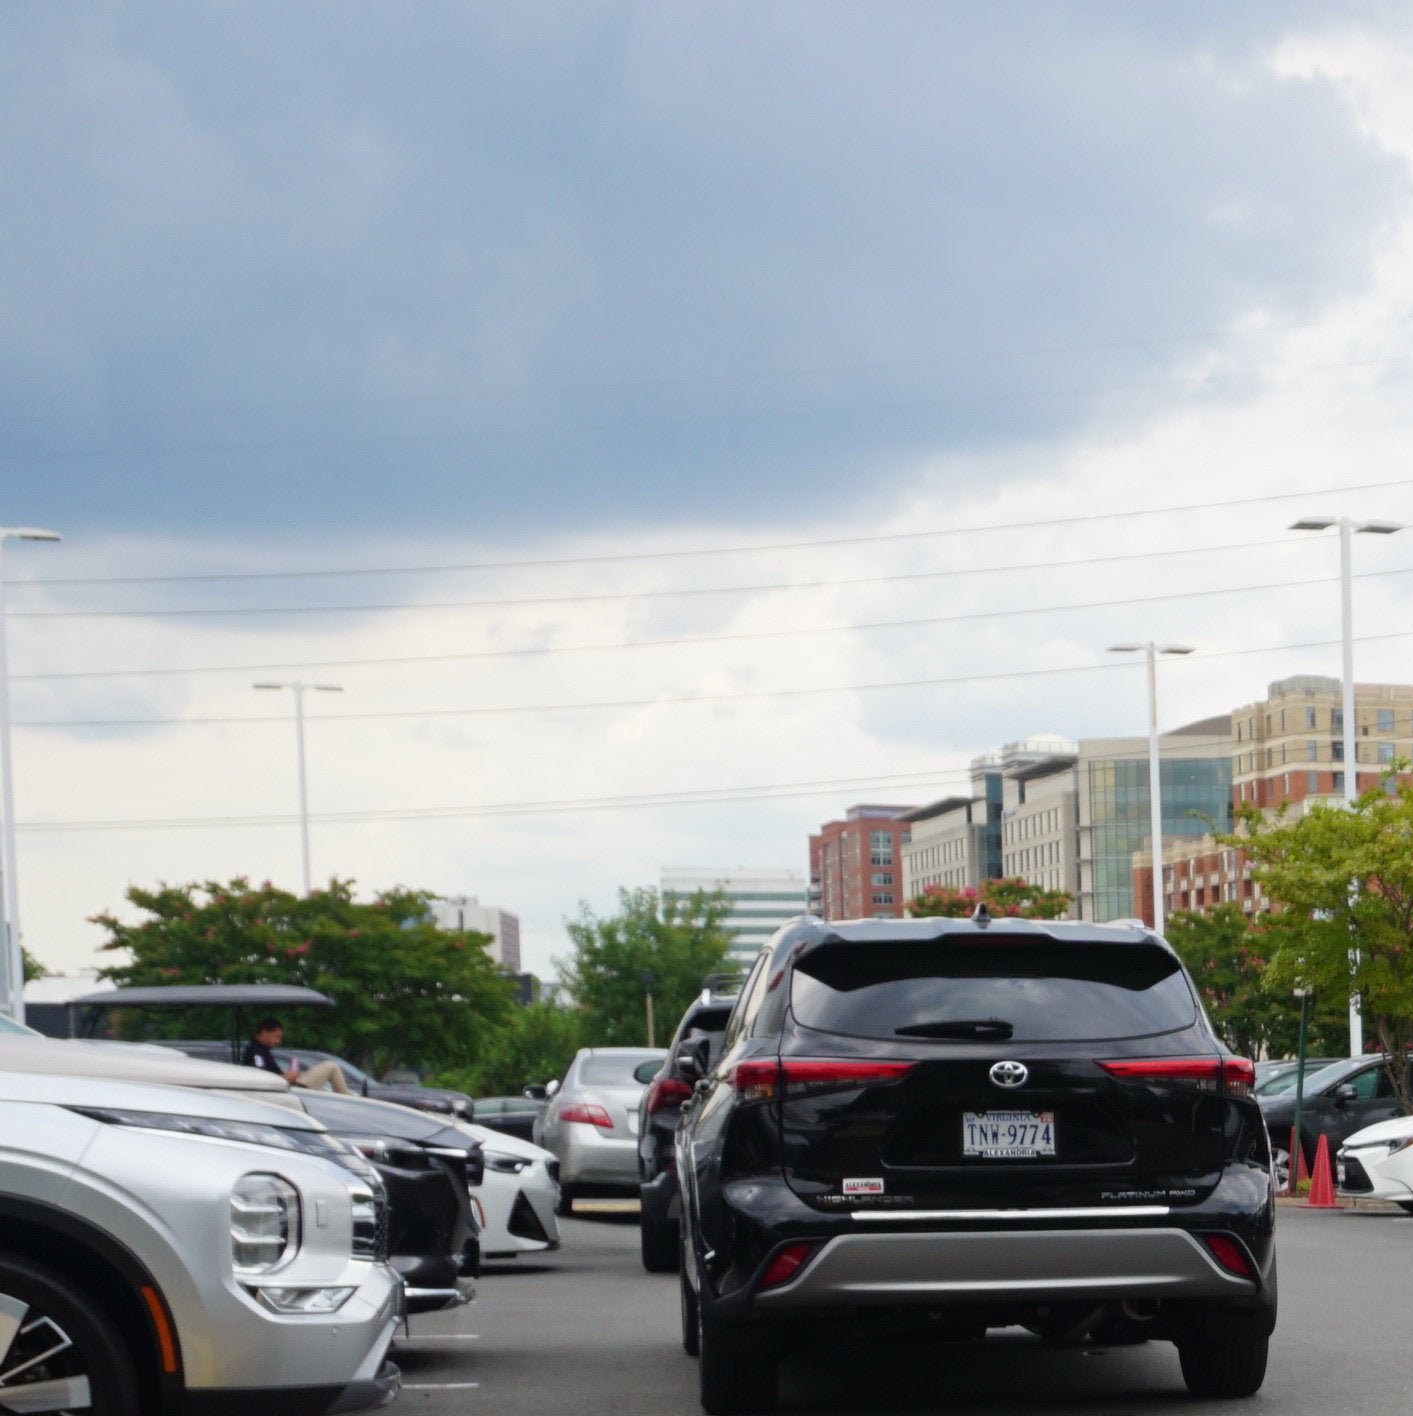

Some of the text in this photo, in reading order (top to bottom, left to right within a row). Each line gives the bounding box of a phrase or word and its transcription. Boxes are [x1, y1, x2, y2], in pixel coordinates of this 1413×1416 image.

[986, 1112, 1031, 1121] VIRGINIA
[967, 1123, 1052, 1145] TNW-9774
[1101, 1190, 1166, 1199] PLATINUM
